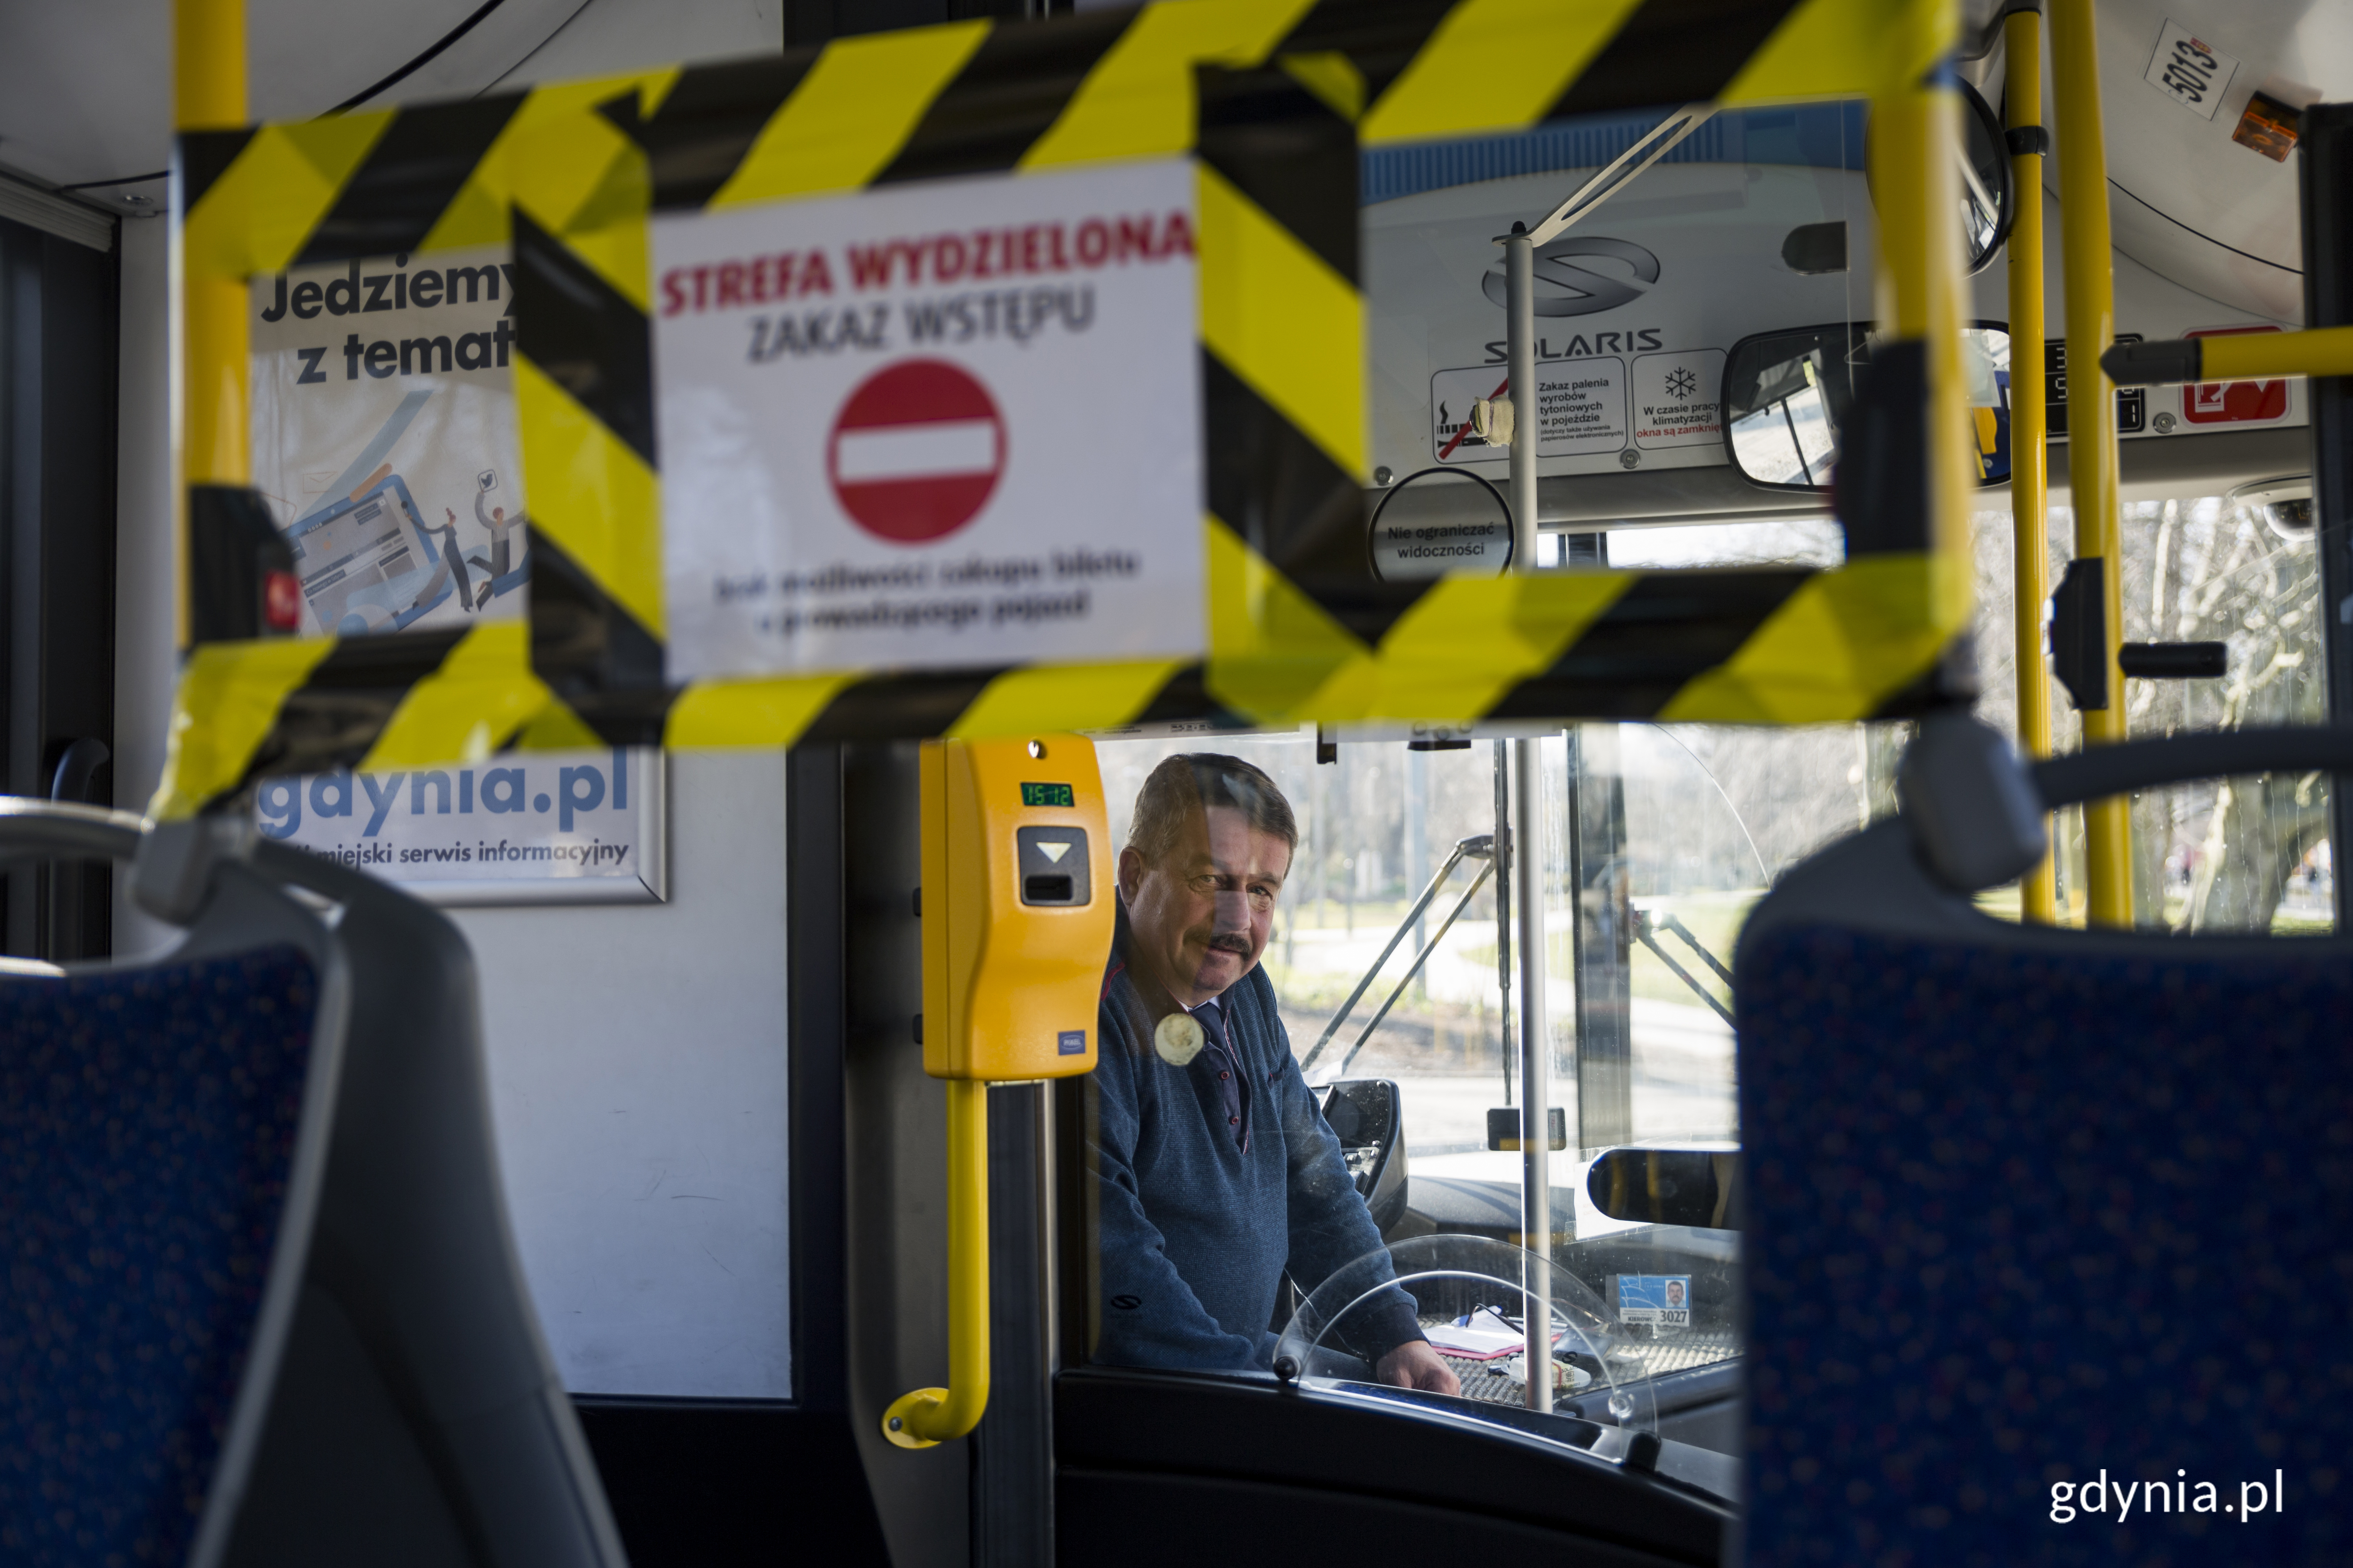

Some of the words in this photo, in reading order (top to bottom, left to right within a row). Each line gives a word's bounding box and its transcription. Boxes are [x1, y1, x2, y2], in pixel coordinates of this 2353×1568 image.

[2162, 41, 2218, 102] 5013
[659, 248, 833, 317] STREFA
[847, 211, 1197, 289] WYDZIELONA
[747, 313, 889, 363] ZAKAZ
[905, 284, 1095, 347] WSTĘPU
[1484, 329, 1663, 364] SLARIS
[296, 347, 327, 384] z
[1539, 382, 1569, 391] Zakaz
[1572, 378, 1608, 390] palenia
[1539, 392, 1586, 404] wyrobów
[1540, 401, 1602, 416] tytoniowych
[1644, 406, 1654, 415] W
[1657, 404, 1689, 414] czasie
[1692, 402, 1720, 413] pracy
[1653, 412, 1712, 425] klimatyzacji
[1541, 434, 1574, 442] papierosów
[1575, 430, 1624, 439] elektronicznych)
[1637, 428, 1661, 438] okna
[1663, 428, 1676, 437] są
[1388, 527, 1412, 540] Nie
[1415, 521, 1494, 541] ograniczać
[1397, 543, 1484, 558] widoczności
[399, 841, 471, 863] serwis
[478, 838, 629, 866] informacyjny
[1660, 1310, 1687, 1322] 3027
